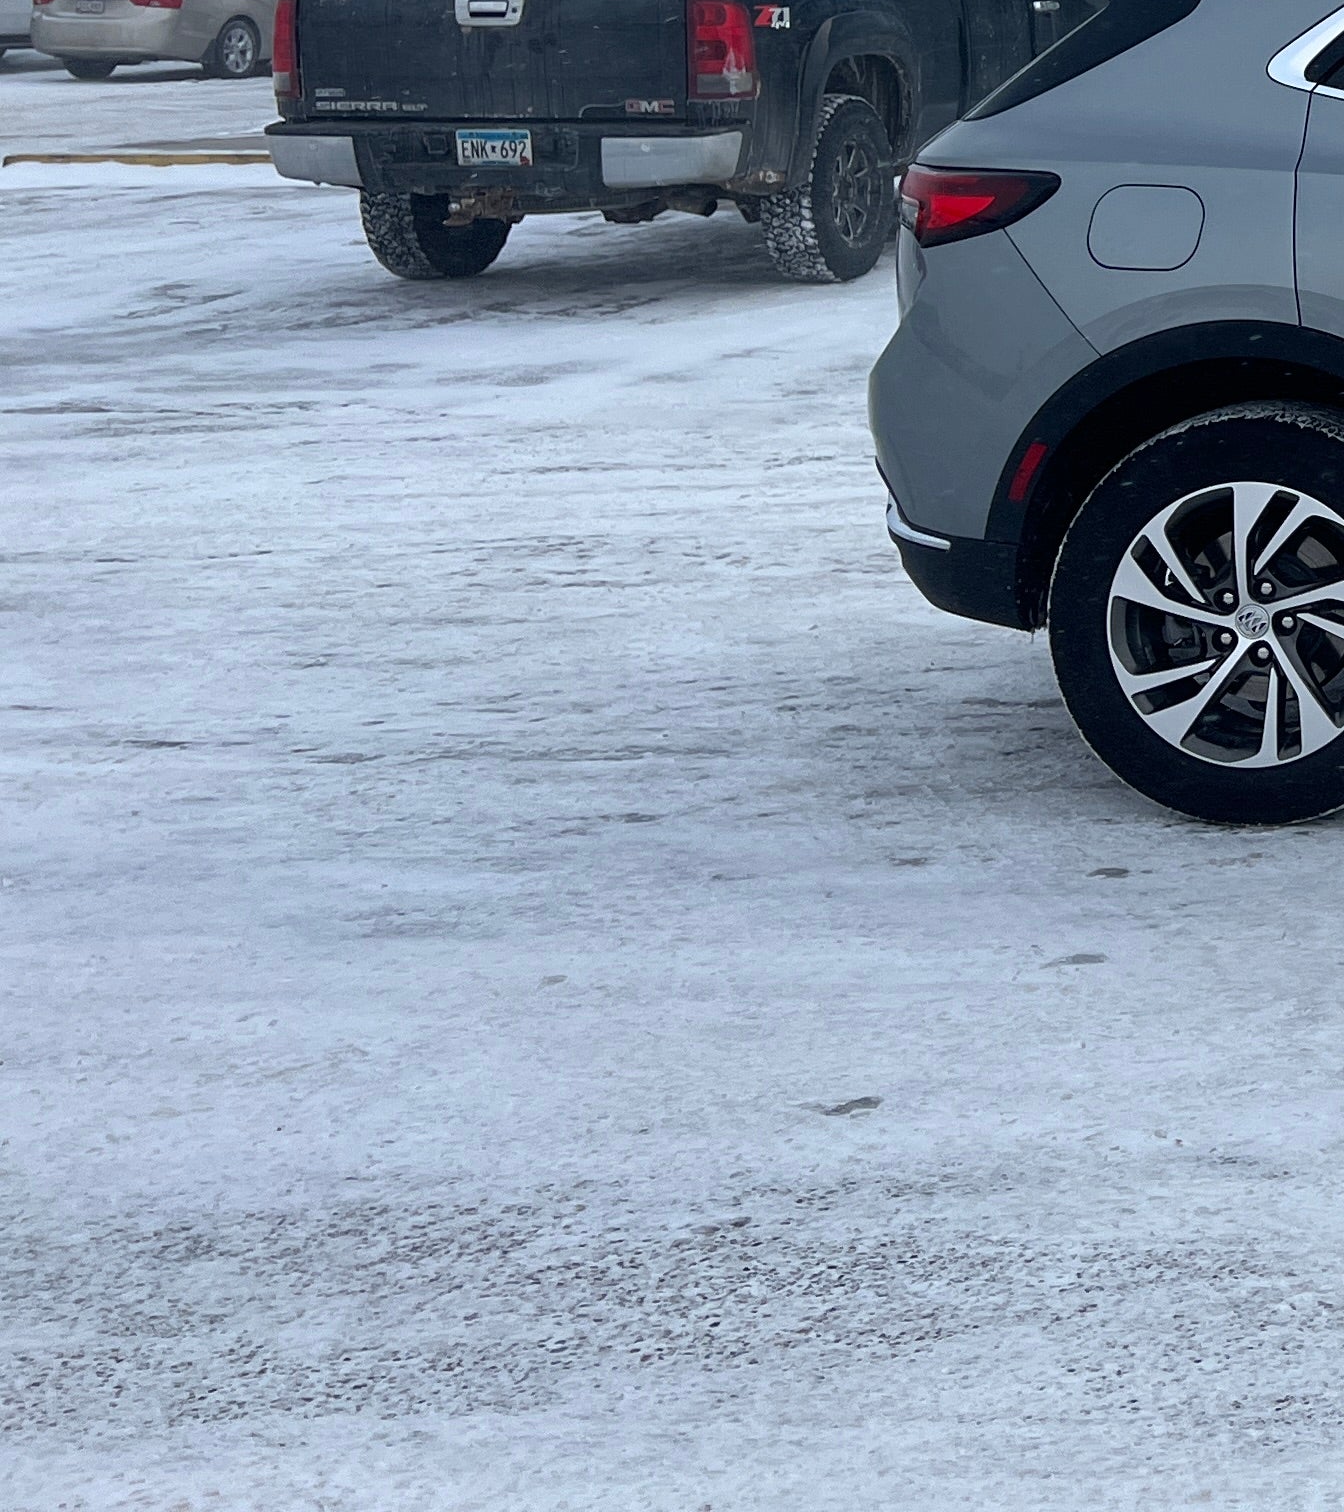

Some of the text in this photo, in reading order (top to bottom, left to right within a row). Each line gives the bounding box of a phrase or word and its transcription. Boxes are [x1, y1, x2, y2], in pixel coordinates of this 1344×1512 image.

[753, 4, 790, 28] Z71
[315, 101, 398, 111] SIERRA
[625, 99, 675, 114] GMC
[461, 139, 527, 160] ENK 692
